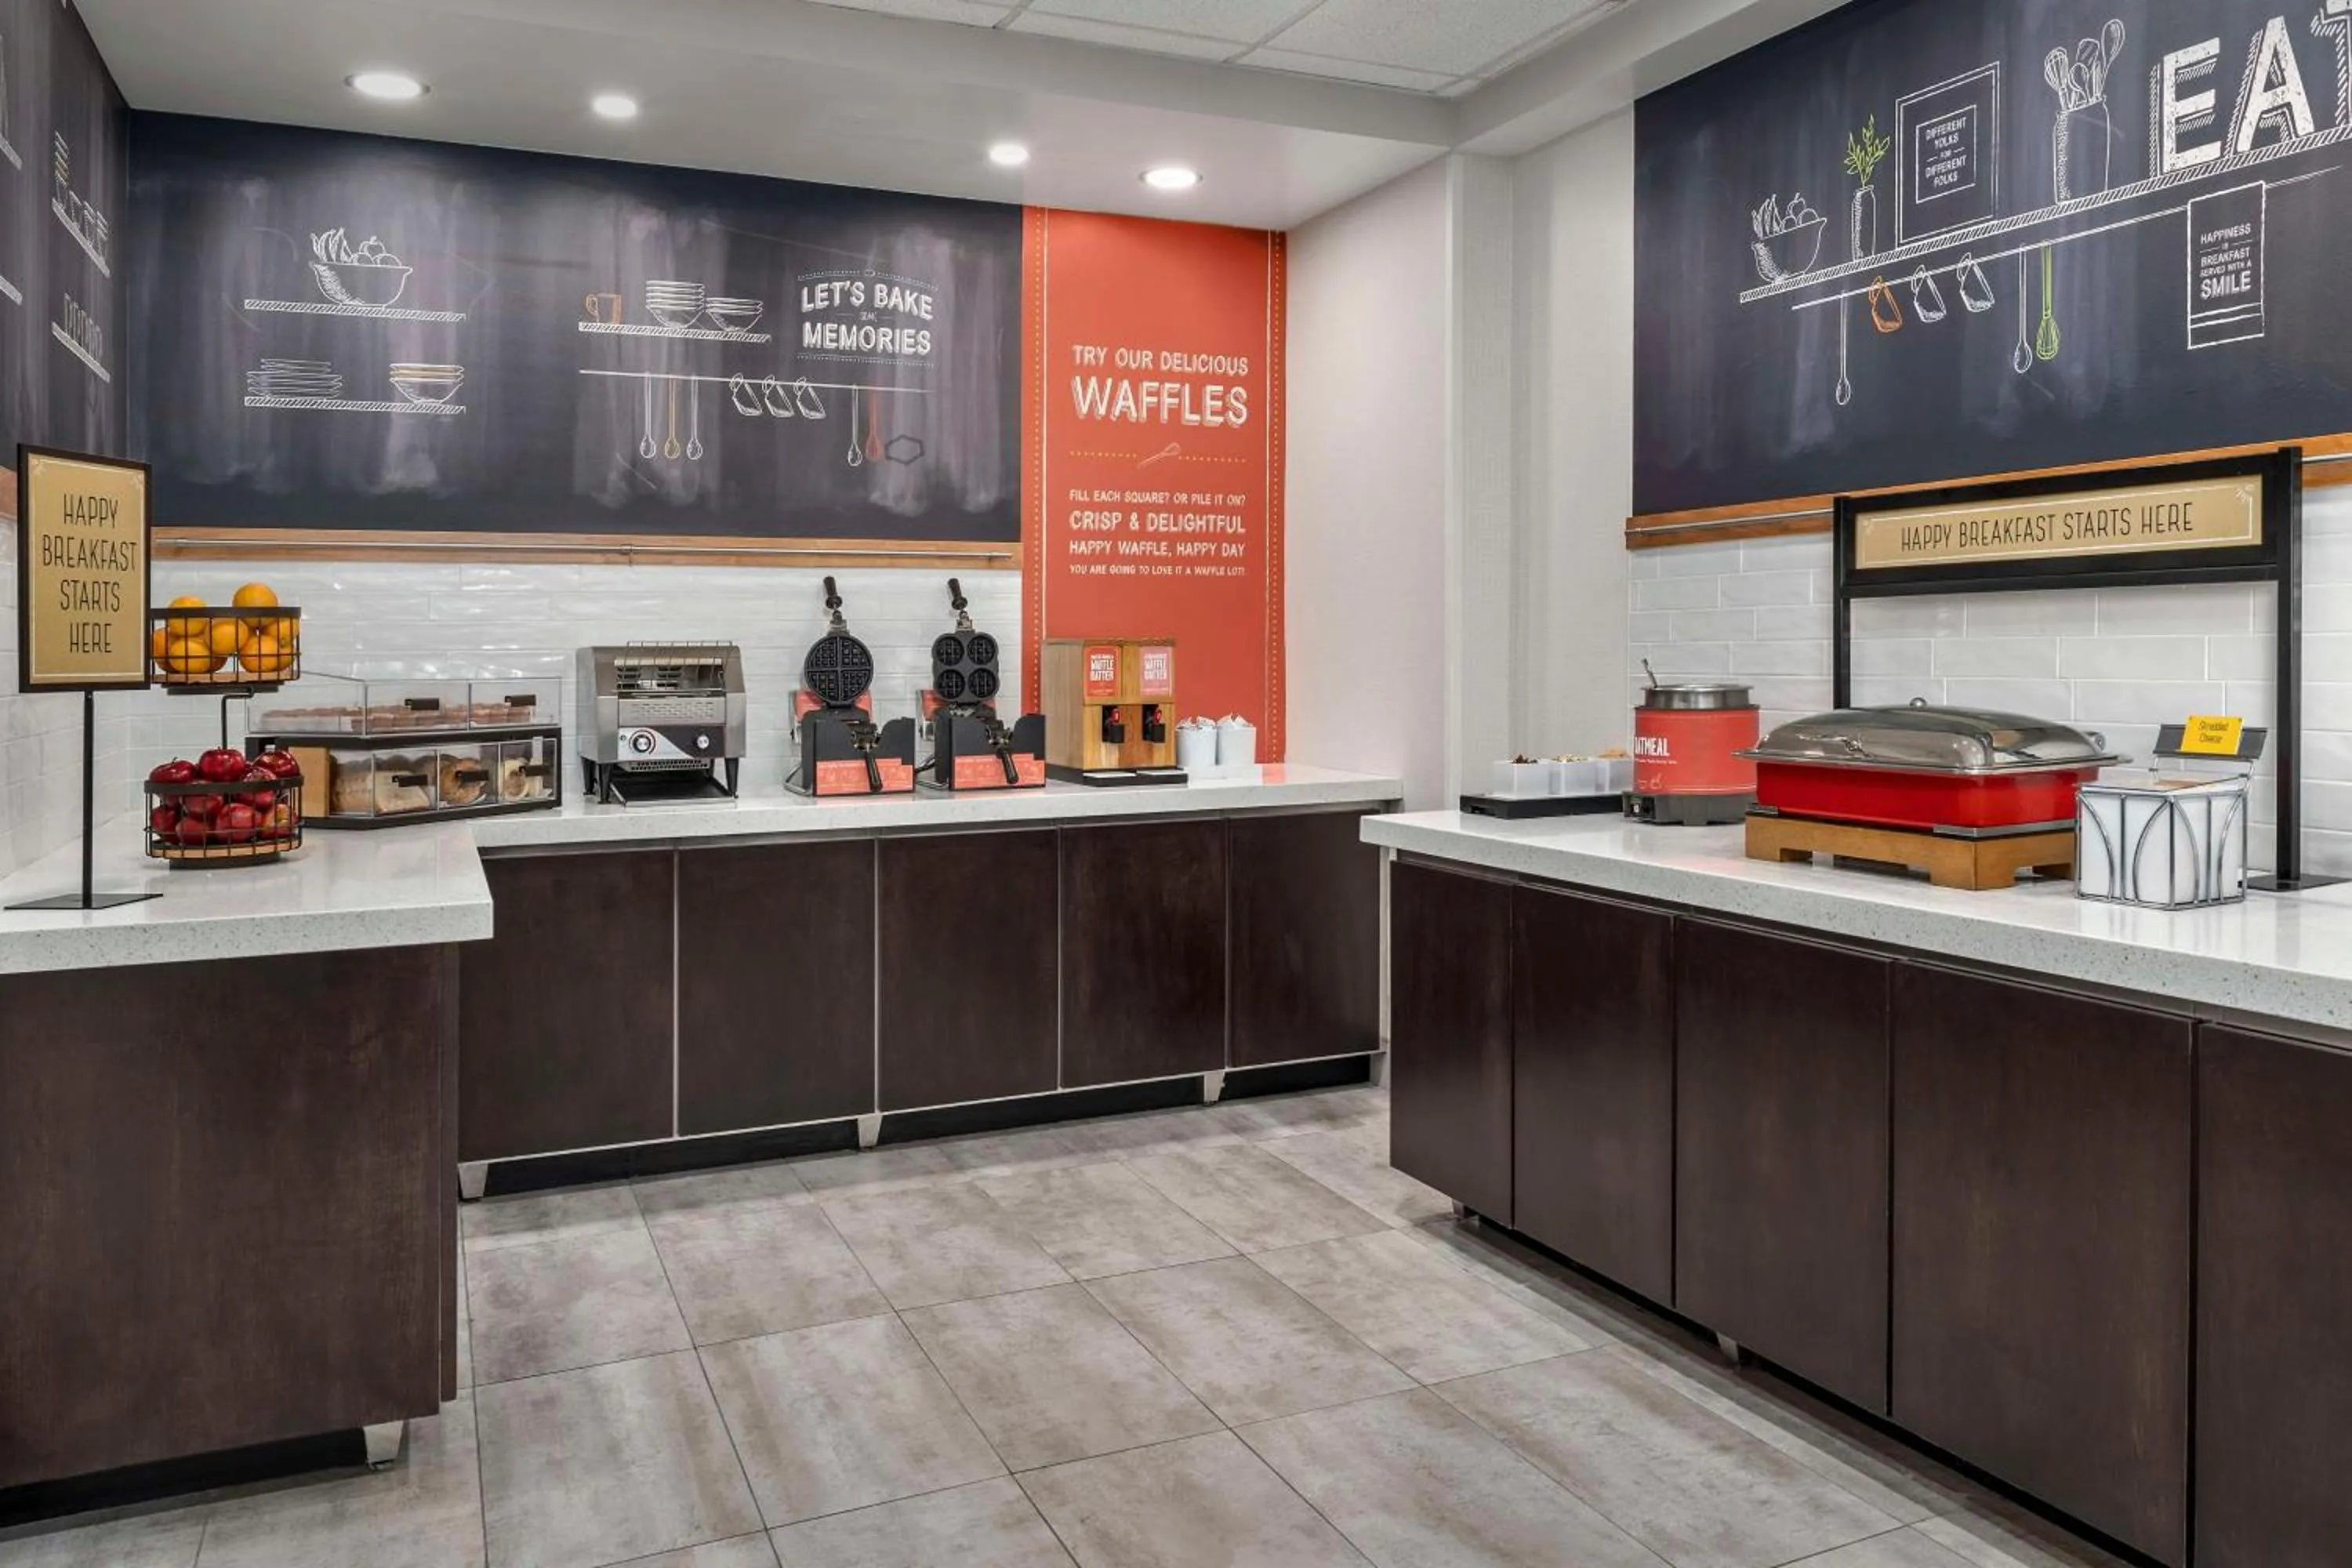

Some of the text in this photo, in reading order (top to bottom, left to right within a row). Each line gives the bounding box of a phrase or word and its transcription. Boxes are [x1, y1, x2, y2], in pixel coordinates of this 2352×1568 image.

[1926, 117, 1966, 140] DIFFERENT
[1934, 132, 1959, 149] YOLKS
[1925, 154, 1966, 179] DIFFERENT
[1933, 170, 1958, 187] FOLKS
[2201, 223, 2251, 245] HAPPINESS
[2200, 259, 2252, 277] SERVED WITH A
[2201, 246, 2250, 267] BREAKFAST
[2200, 270, 2252, 299] SMILE
[800, 280, 934, 321] LET'S BAKE
[802, 321, 931, 355] MEMORIES
[1073, 344, 1248, 376] TRY OUR DELICIOUS
[1071, 376, 1248, 428] WAFFLES
[1069, 488, 1247, 507] FILL EACH SQUARE? OR PILE IT ON?
[63, 493, 118, 528] HAPPY
[1069, 510, 1247, 534] CRISP & DELIGHTFUL
[1901, 502, 2194, 553] HAPPY BREAKFAST STARTS HERE
[42, 534, 137, 572] BREAKFAST
[1069, 539, 1247, 558] HAPPY WAFFLE, HAPPY DAY
[1069, 564, 1087, 575] YOU
[1089, 564, 1107, 575] ARE
[1109, 564, 1136, 575] GOING
[1139, 564, 1150, 575] TO
[1152, 564, 1173, 575] LOVE
[1175, 565, 1183, 575] IT
[1185, 566, 1192, 575] A
[1194, 565, 1225, 577] WAFFLE
[60, 579, 120, 612] STARTS
[69, 622, 112, 654] HERE
